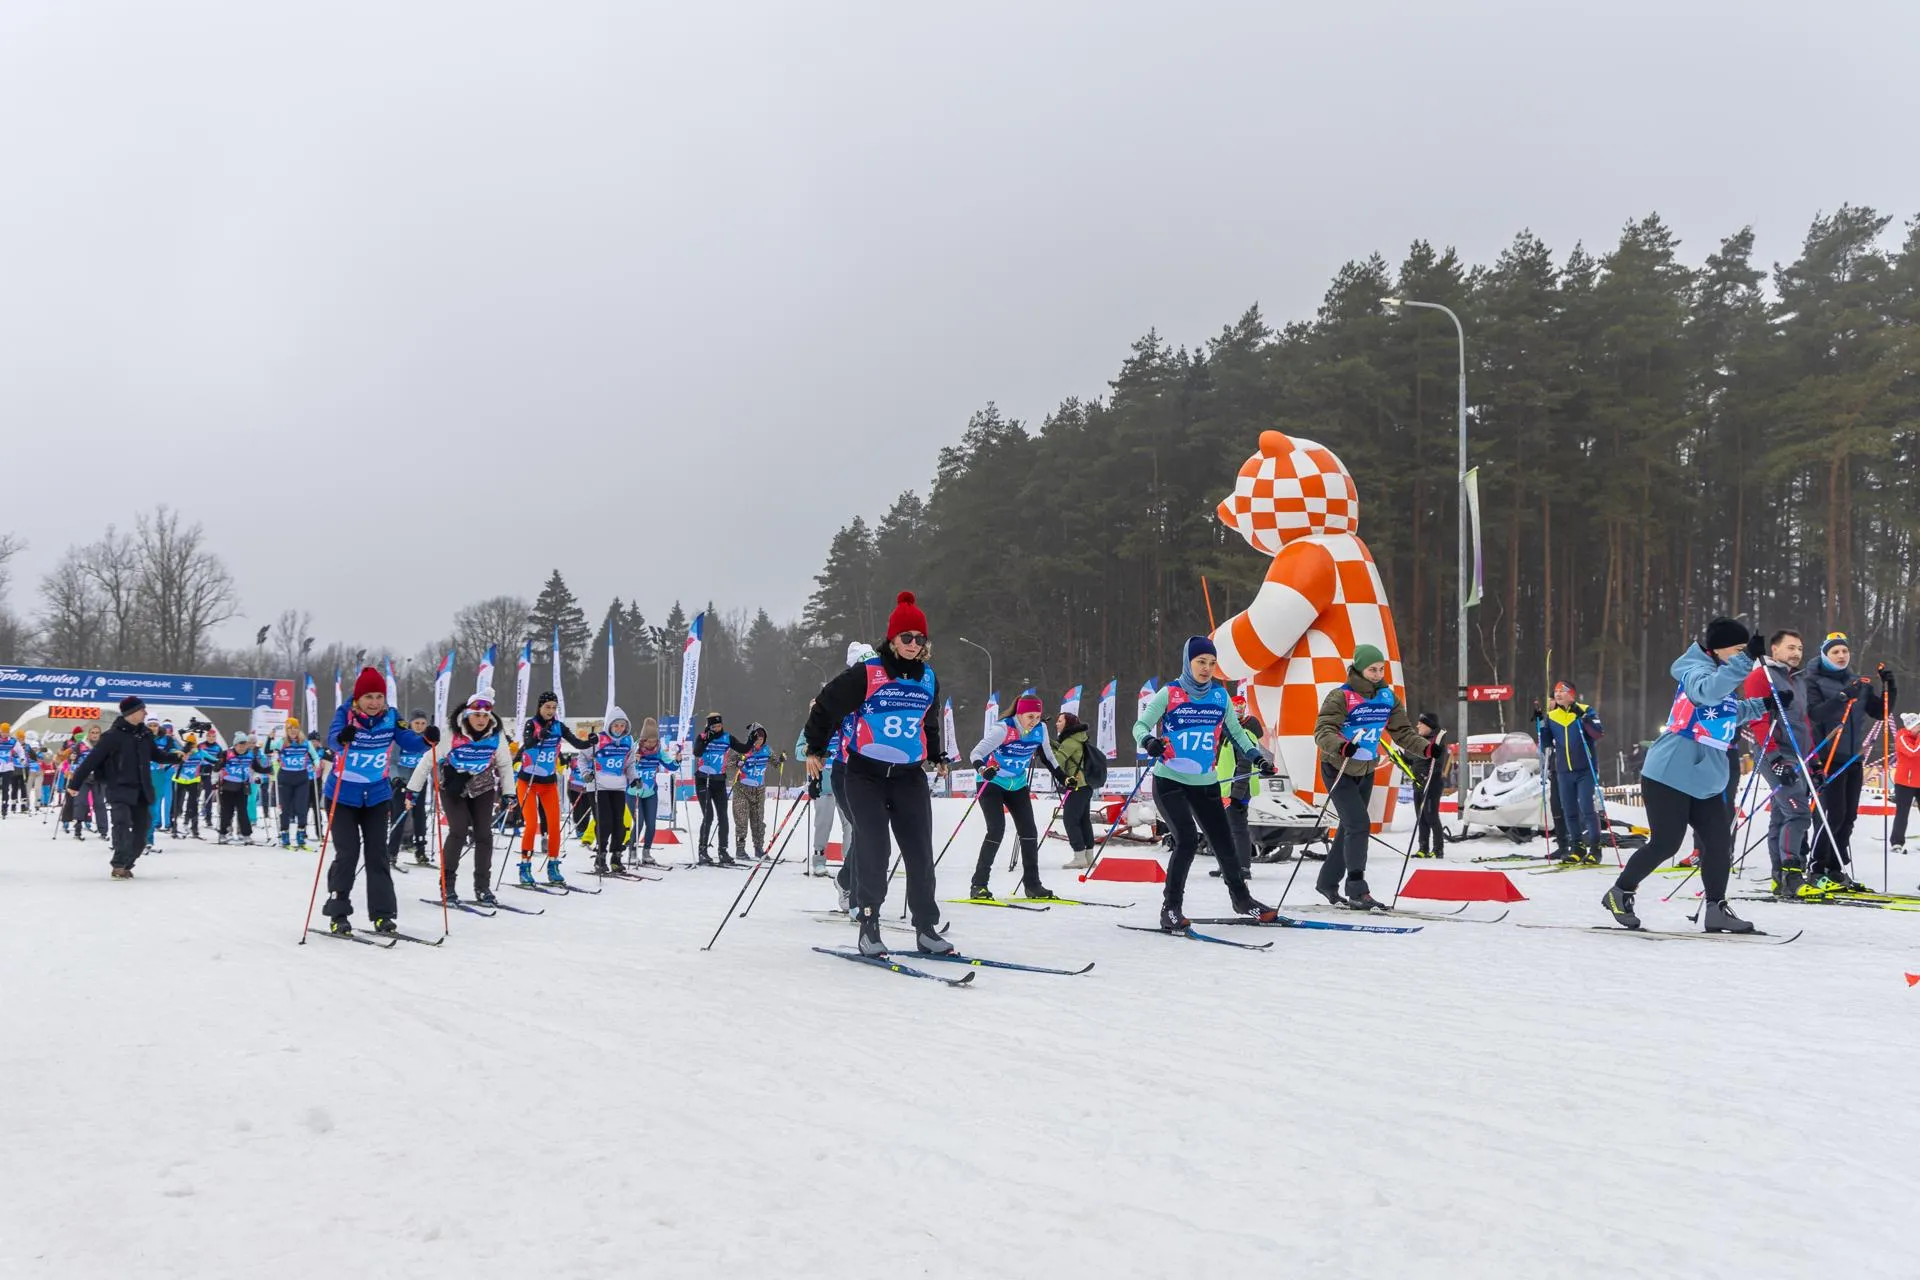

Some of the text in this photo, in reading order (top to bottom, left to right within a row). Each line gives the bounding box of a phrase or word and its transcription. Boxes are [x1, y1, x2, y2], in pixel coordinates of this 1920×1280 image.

[107, 679, 172, 688] СОВКОМБАНК
[53, 687, 98, 698] СТАРТ
[883, 715, 921, 739] 83
[1177, 731, 1215, 751] 175
[348, 752, 388, 769] 178
[606, 758, 624, 769] 86
